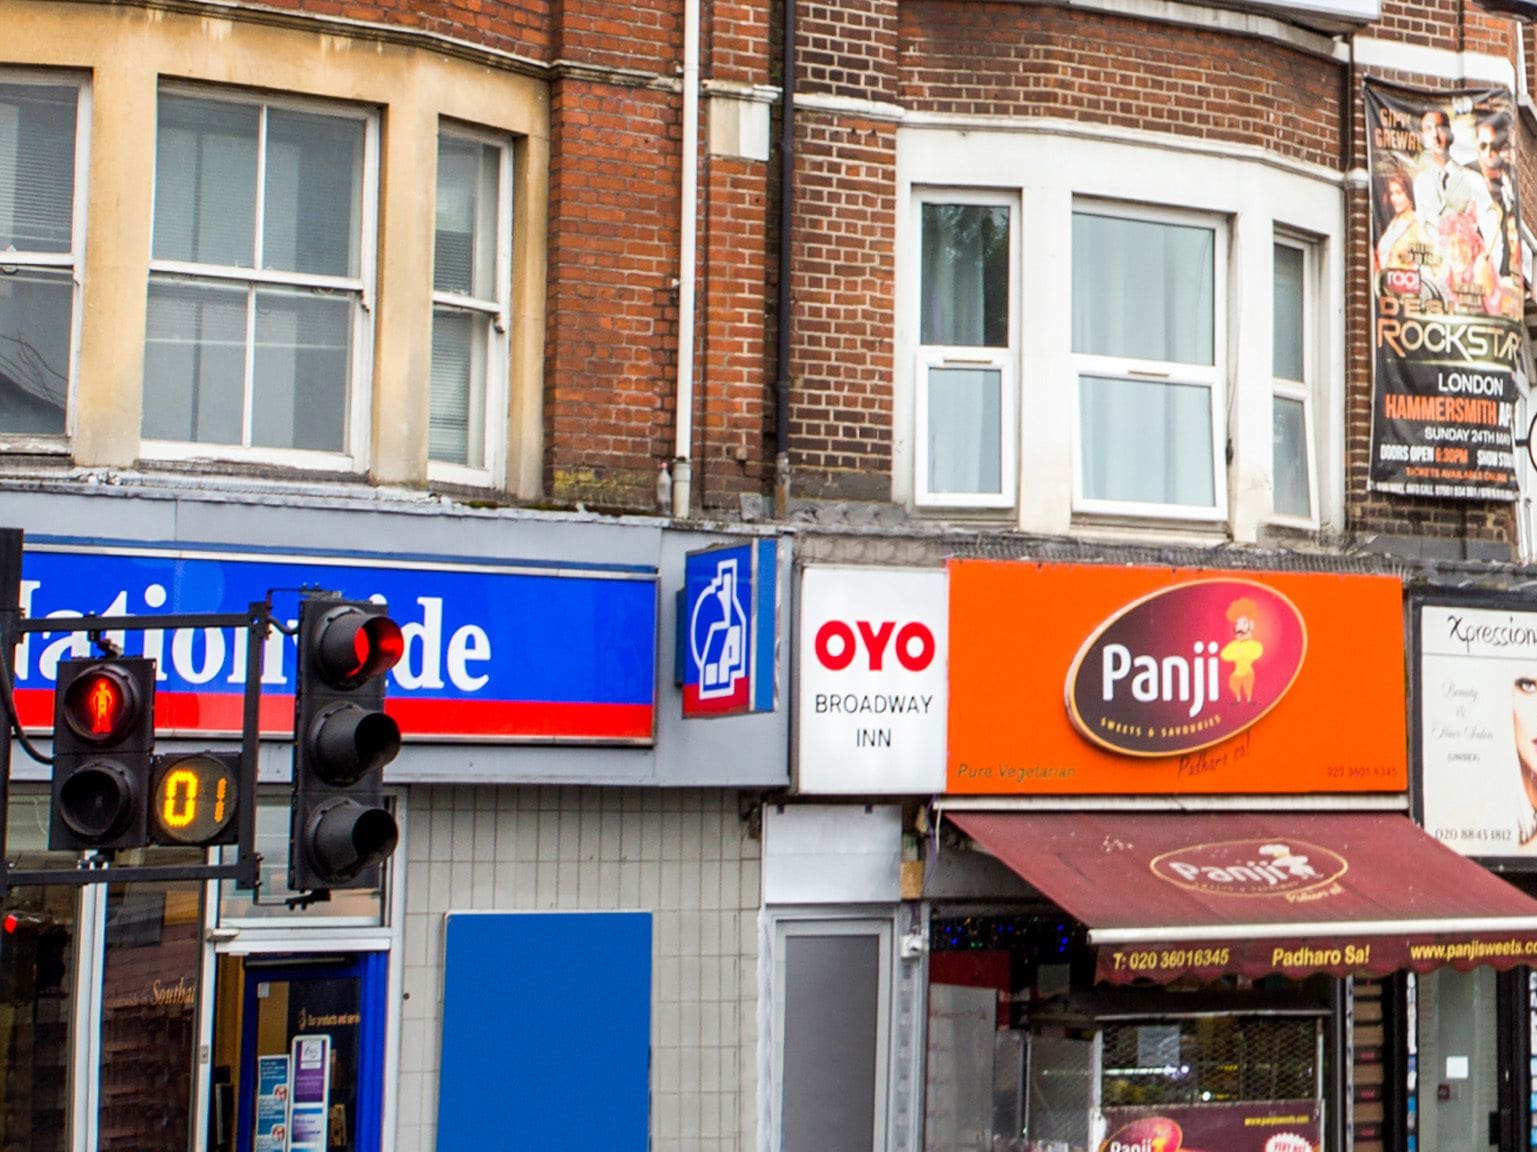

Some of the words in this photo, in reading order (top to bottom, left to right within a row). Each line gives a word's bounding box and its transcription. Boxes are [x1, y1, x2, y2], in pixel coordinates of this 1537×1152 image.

[1437, 373, 1504, 396] LONDON
[1385, 394, 1497, 425] HAMMERSMITH
[1424, 426, 1469, 442] SUNDAY
[1471, 429, 1495, 444] 24TH
[1380, 444, 1409, 461] DOORS
[1410, 445, 1435, 462] OPEN
[814, 619, 936, 673] OYO
[1102, 641, 1220, 718] Panji
[814, 693, 934, 715] BROADWAY
[1101, 715, 1142, 737] SWEETS
[856, 728, 892, 748] INN
[957, 763, 992, 778] Pure
[999, 764, 1077, 783] Vegetarian
[162, 769, 227, 828] 01
[1435, 828, 1458, 841] 020
[1169, 860, 1288, 885] Panji
[1113, 953, 1126, 970] T:
[1129, 952, 1156, 970] 020
[1160, 948, 1229, 969] 36016345
[1271, 948, 1341, 967] Padharo
[1344, 944, 1370, 965] Sa!
